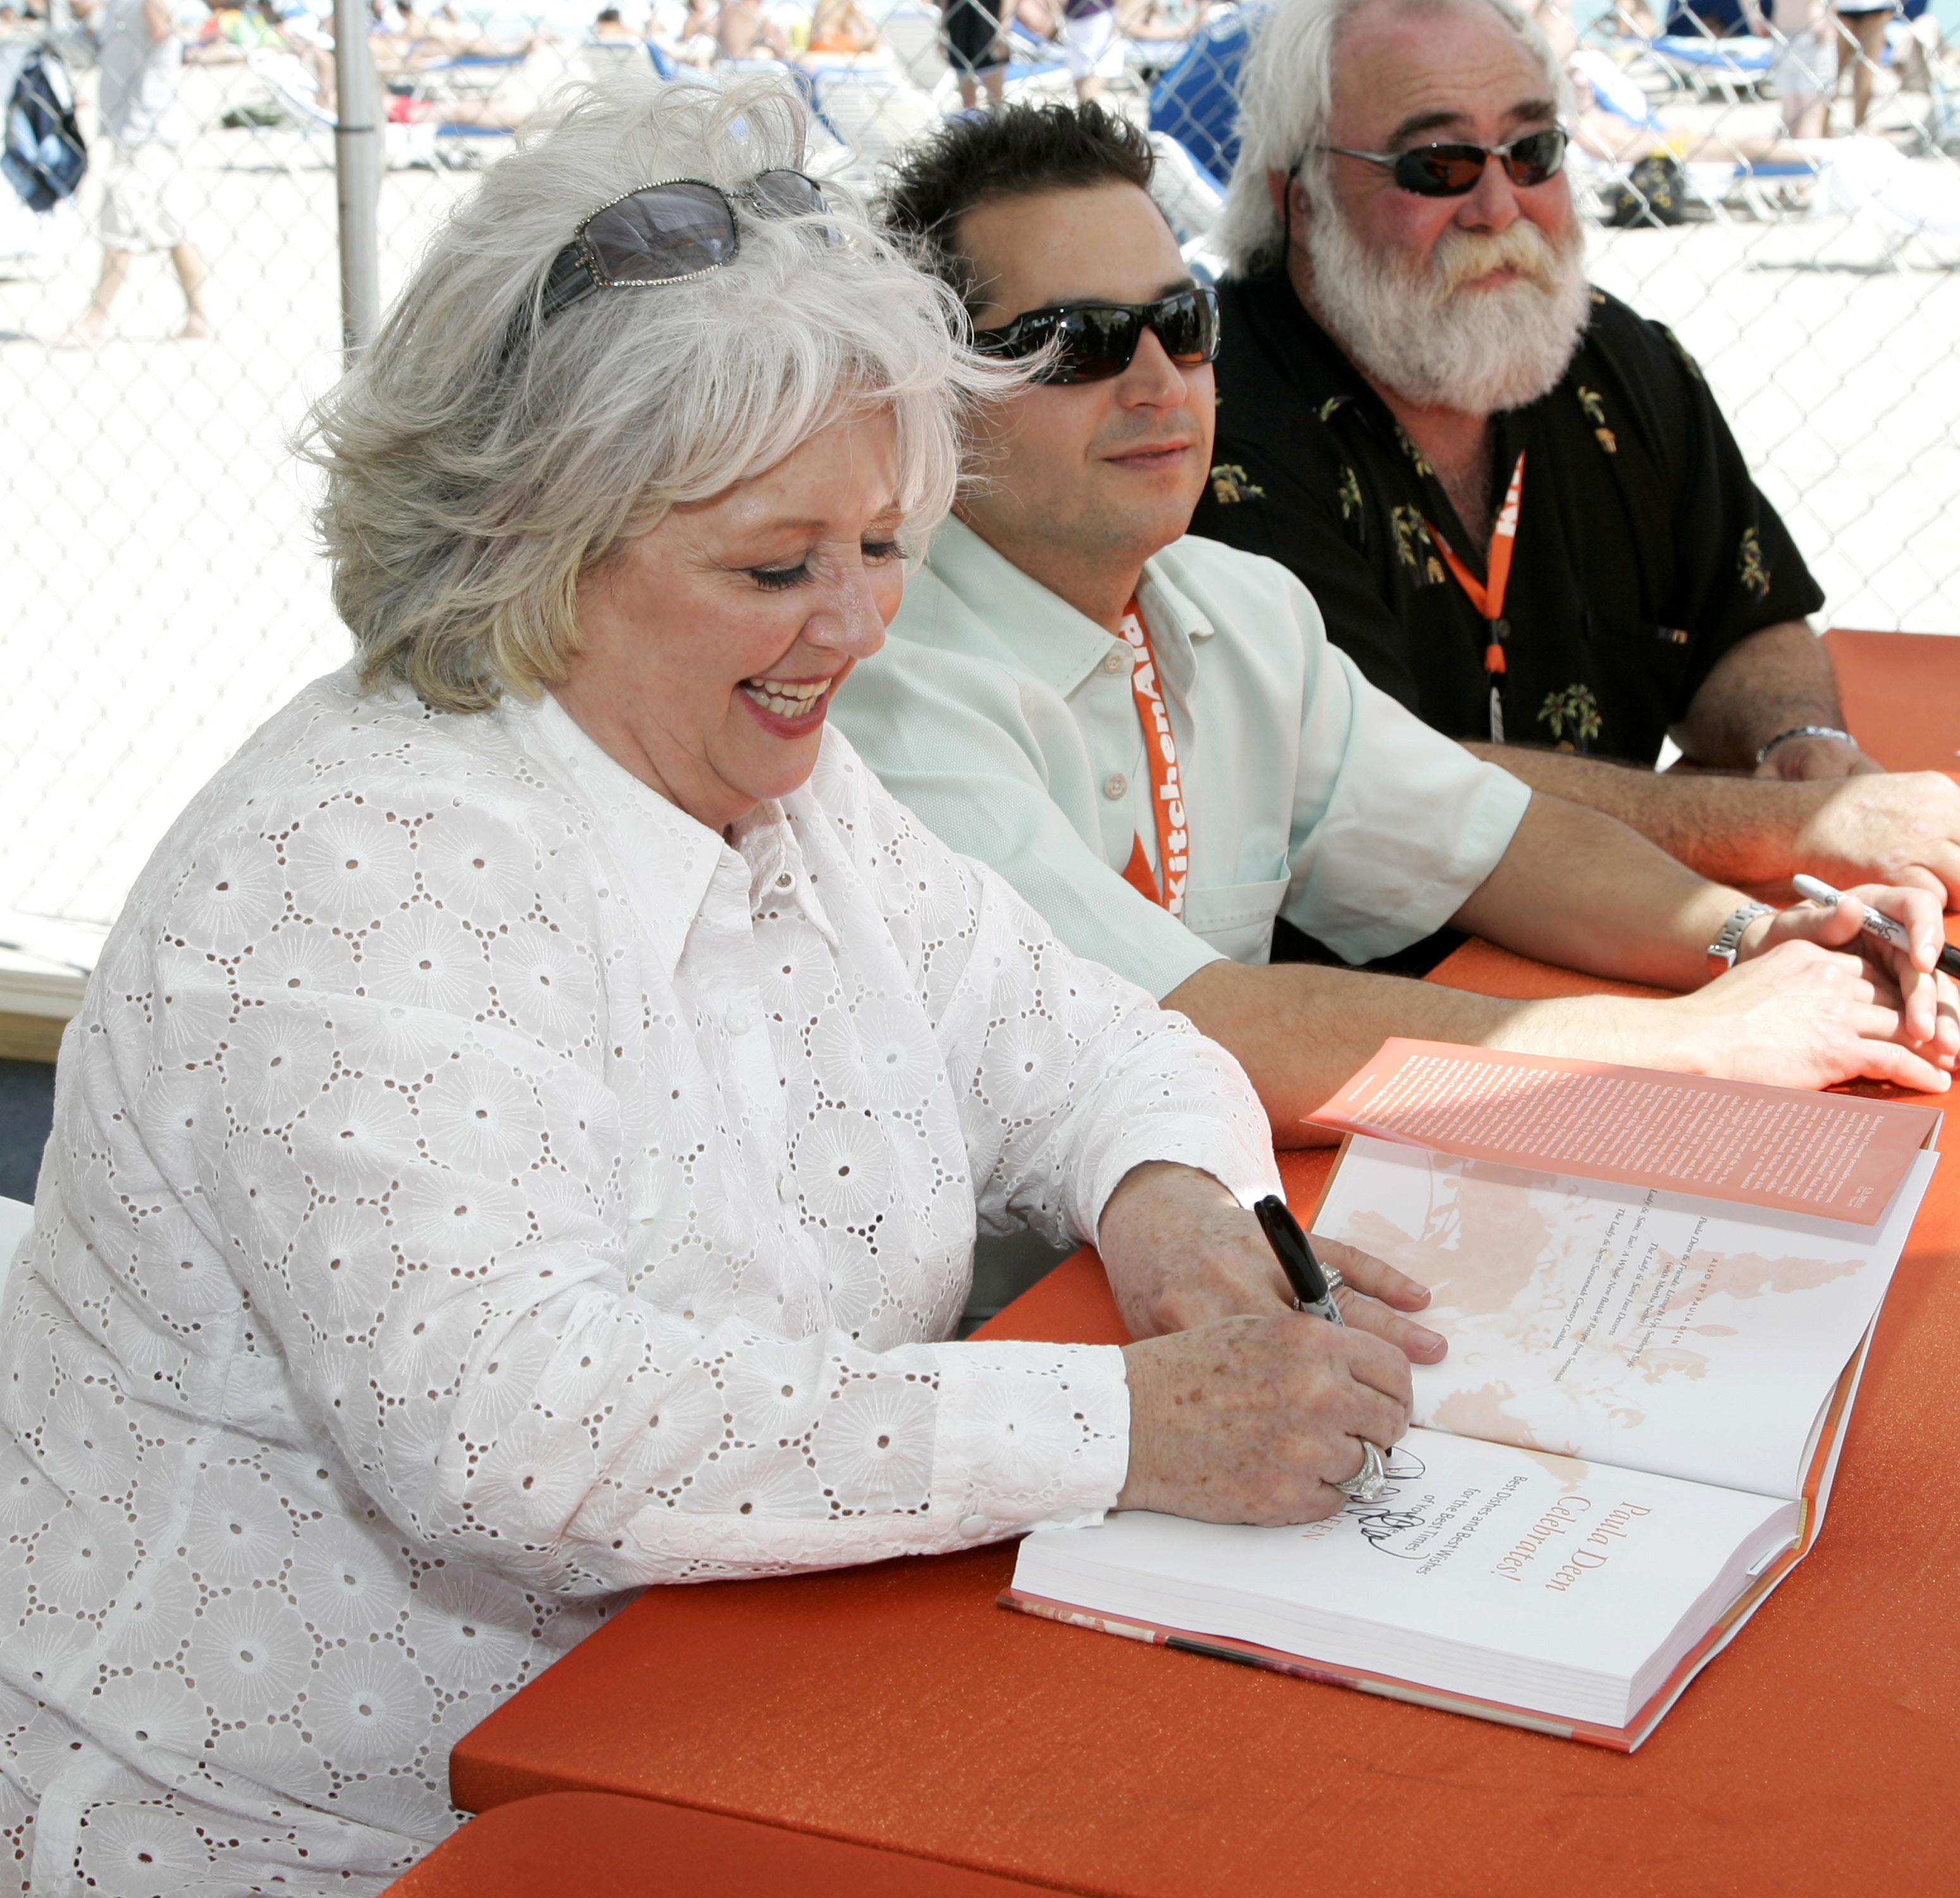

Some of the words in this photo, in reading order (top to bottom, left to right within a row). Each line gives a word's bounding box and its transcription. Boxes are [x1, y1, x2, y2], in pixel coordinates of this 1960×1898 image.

[1119, 613, 1189, 915] KitchenAid
[1502, 1476, 1528, 1491] Best
[1421, 1495, 1434, 1504] of
[1461, 1488, 1480, 1498] for
[1446, 1500, 1468, 1511] the
[1477, 1492, 1511, 1515] Dishes
[1428, 1513, 1454, 1529] Best
[1462, 1516, 1482, 1531] and
[1587, 1501, 1651, 1544] Paula
[1405, 1530, 1438, 1551] Times
[1444, 1532, 1471, 1548] Best
[1491, 1496, 1591, 1581] Celebrates!
[1416, 1550, 1454, 1574] Wishes
[1546, 1548, 1607, 1591] Deen
